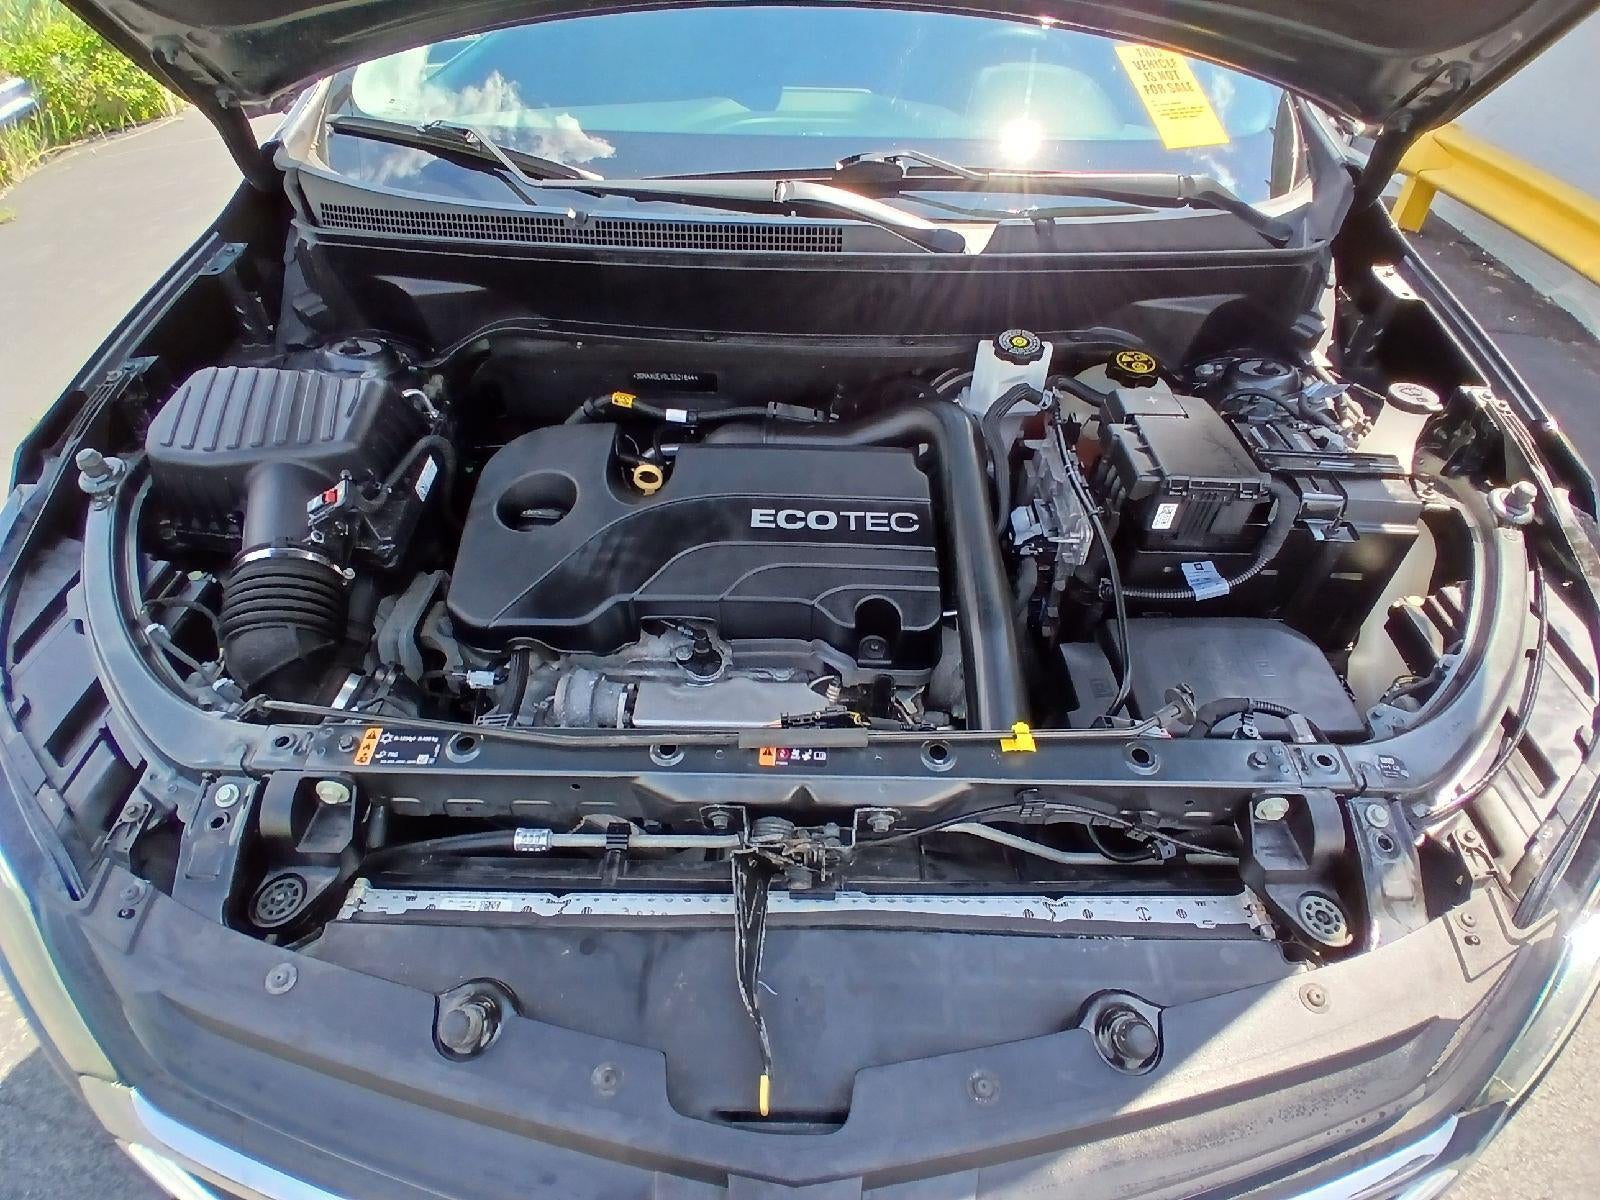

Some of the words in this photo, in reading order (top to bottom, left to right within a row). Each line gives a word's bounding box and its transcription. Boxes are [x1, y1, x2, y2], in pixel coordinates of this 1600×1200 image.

[1132, 58, 1176, 70] VEHICLE
[1143, 71, 1157, 82] IS
[1157, 70, 1180, 81] NOT
[1143, 83, 1166, 95] FOR
[1166, 81, 1194, 94] SALE
[751, 509, 920, 533] ECOTEC
